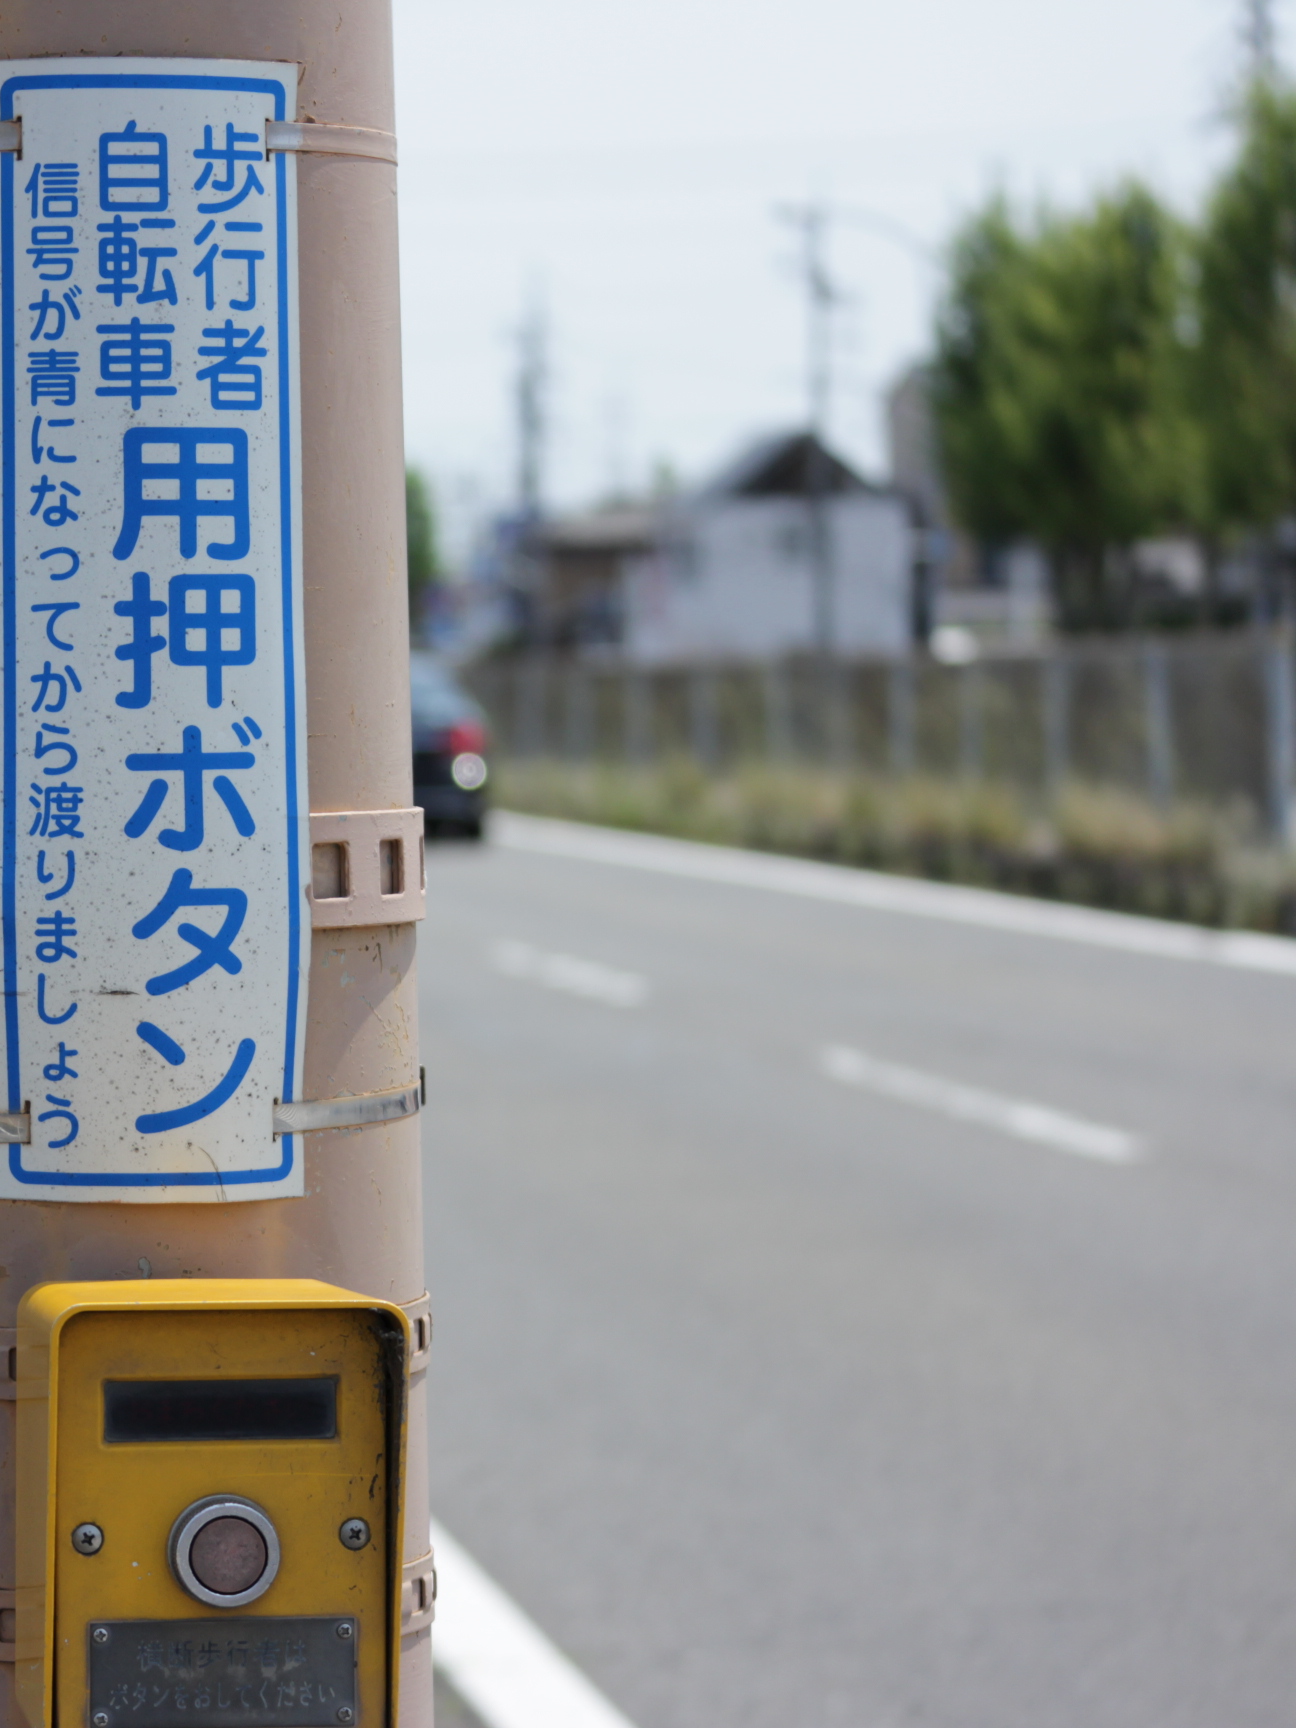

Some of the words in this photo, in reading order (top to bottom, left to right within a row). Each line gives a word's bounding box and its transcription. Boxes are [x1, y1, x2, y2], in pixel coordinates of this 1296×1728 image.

[95, 119, 179, 412] 自転車
[193, 121, 268, 412] 歩行者
[24, 162, 85, 1149] 信号が青になってから渡りましょう
[112, 426, 264, 1135] 用押ボタン
[109, 1681, 336, 1711] ボタンをおしてください
